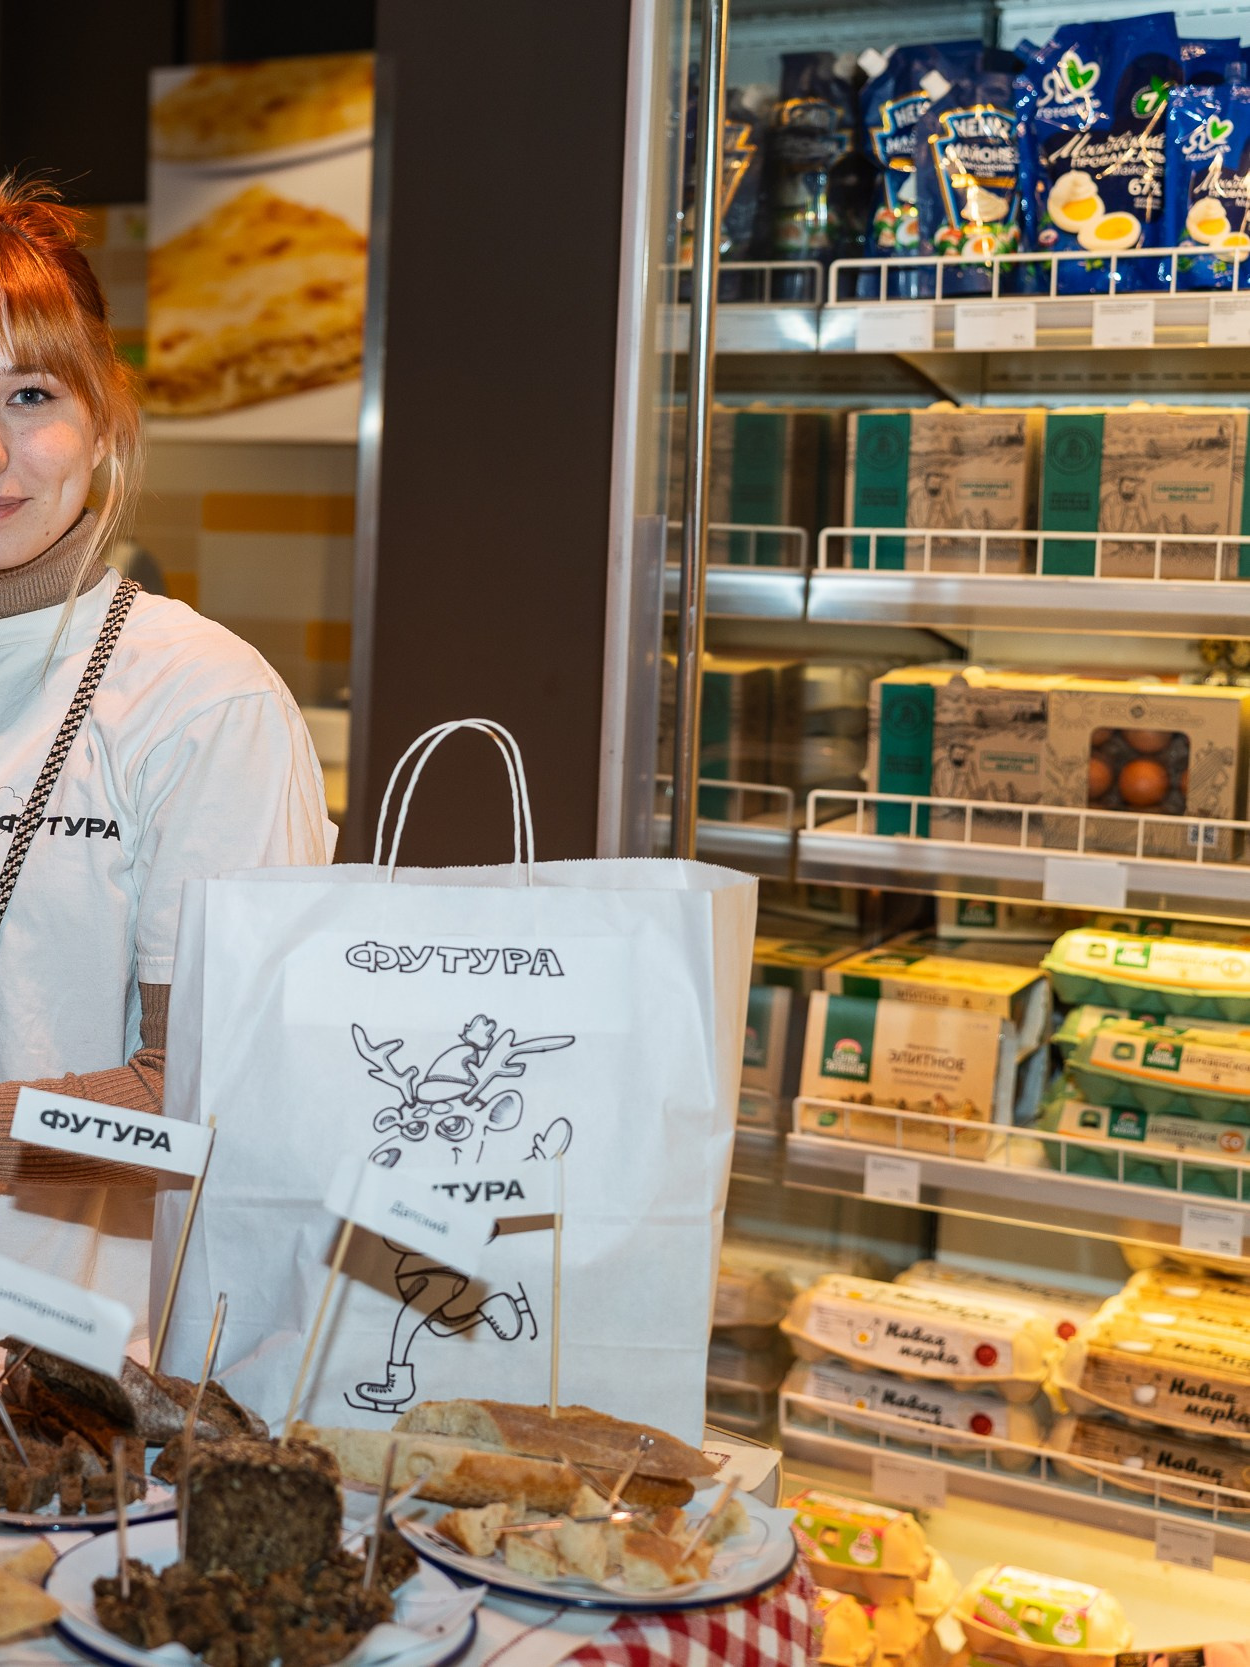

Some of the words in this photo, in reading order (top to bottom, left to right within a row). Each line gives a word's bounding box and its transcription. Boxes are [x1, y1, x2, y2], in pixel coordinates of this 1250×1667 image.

[1128, 177, 1163, 197] 67%
[346, 940, 565, 977] ФУТУРА
[888, 1049, 967, 1072] ЭЛИТНОЕ
[39, 1108, 173, 1153] ФУТУРА
[885, 1320, 947, 1347] Новая
[899, 1344, 960, 1366] марка
[881, 1387, 943, 1416] Новая
[1169, 1376, 1239, 1406] Новая
[1184, 1402, 1250, 1425] марка
[1156, 1449, 1225, 1480] Новая
